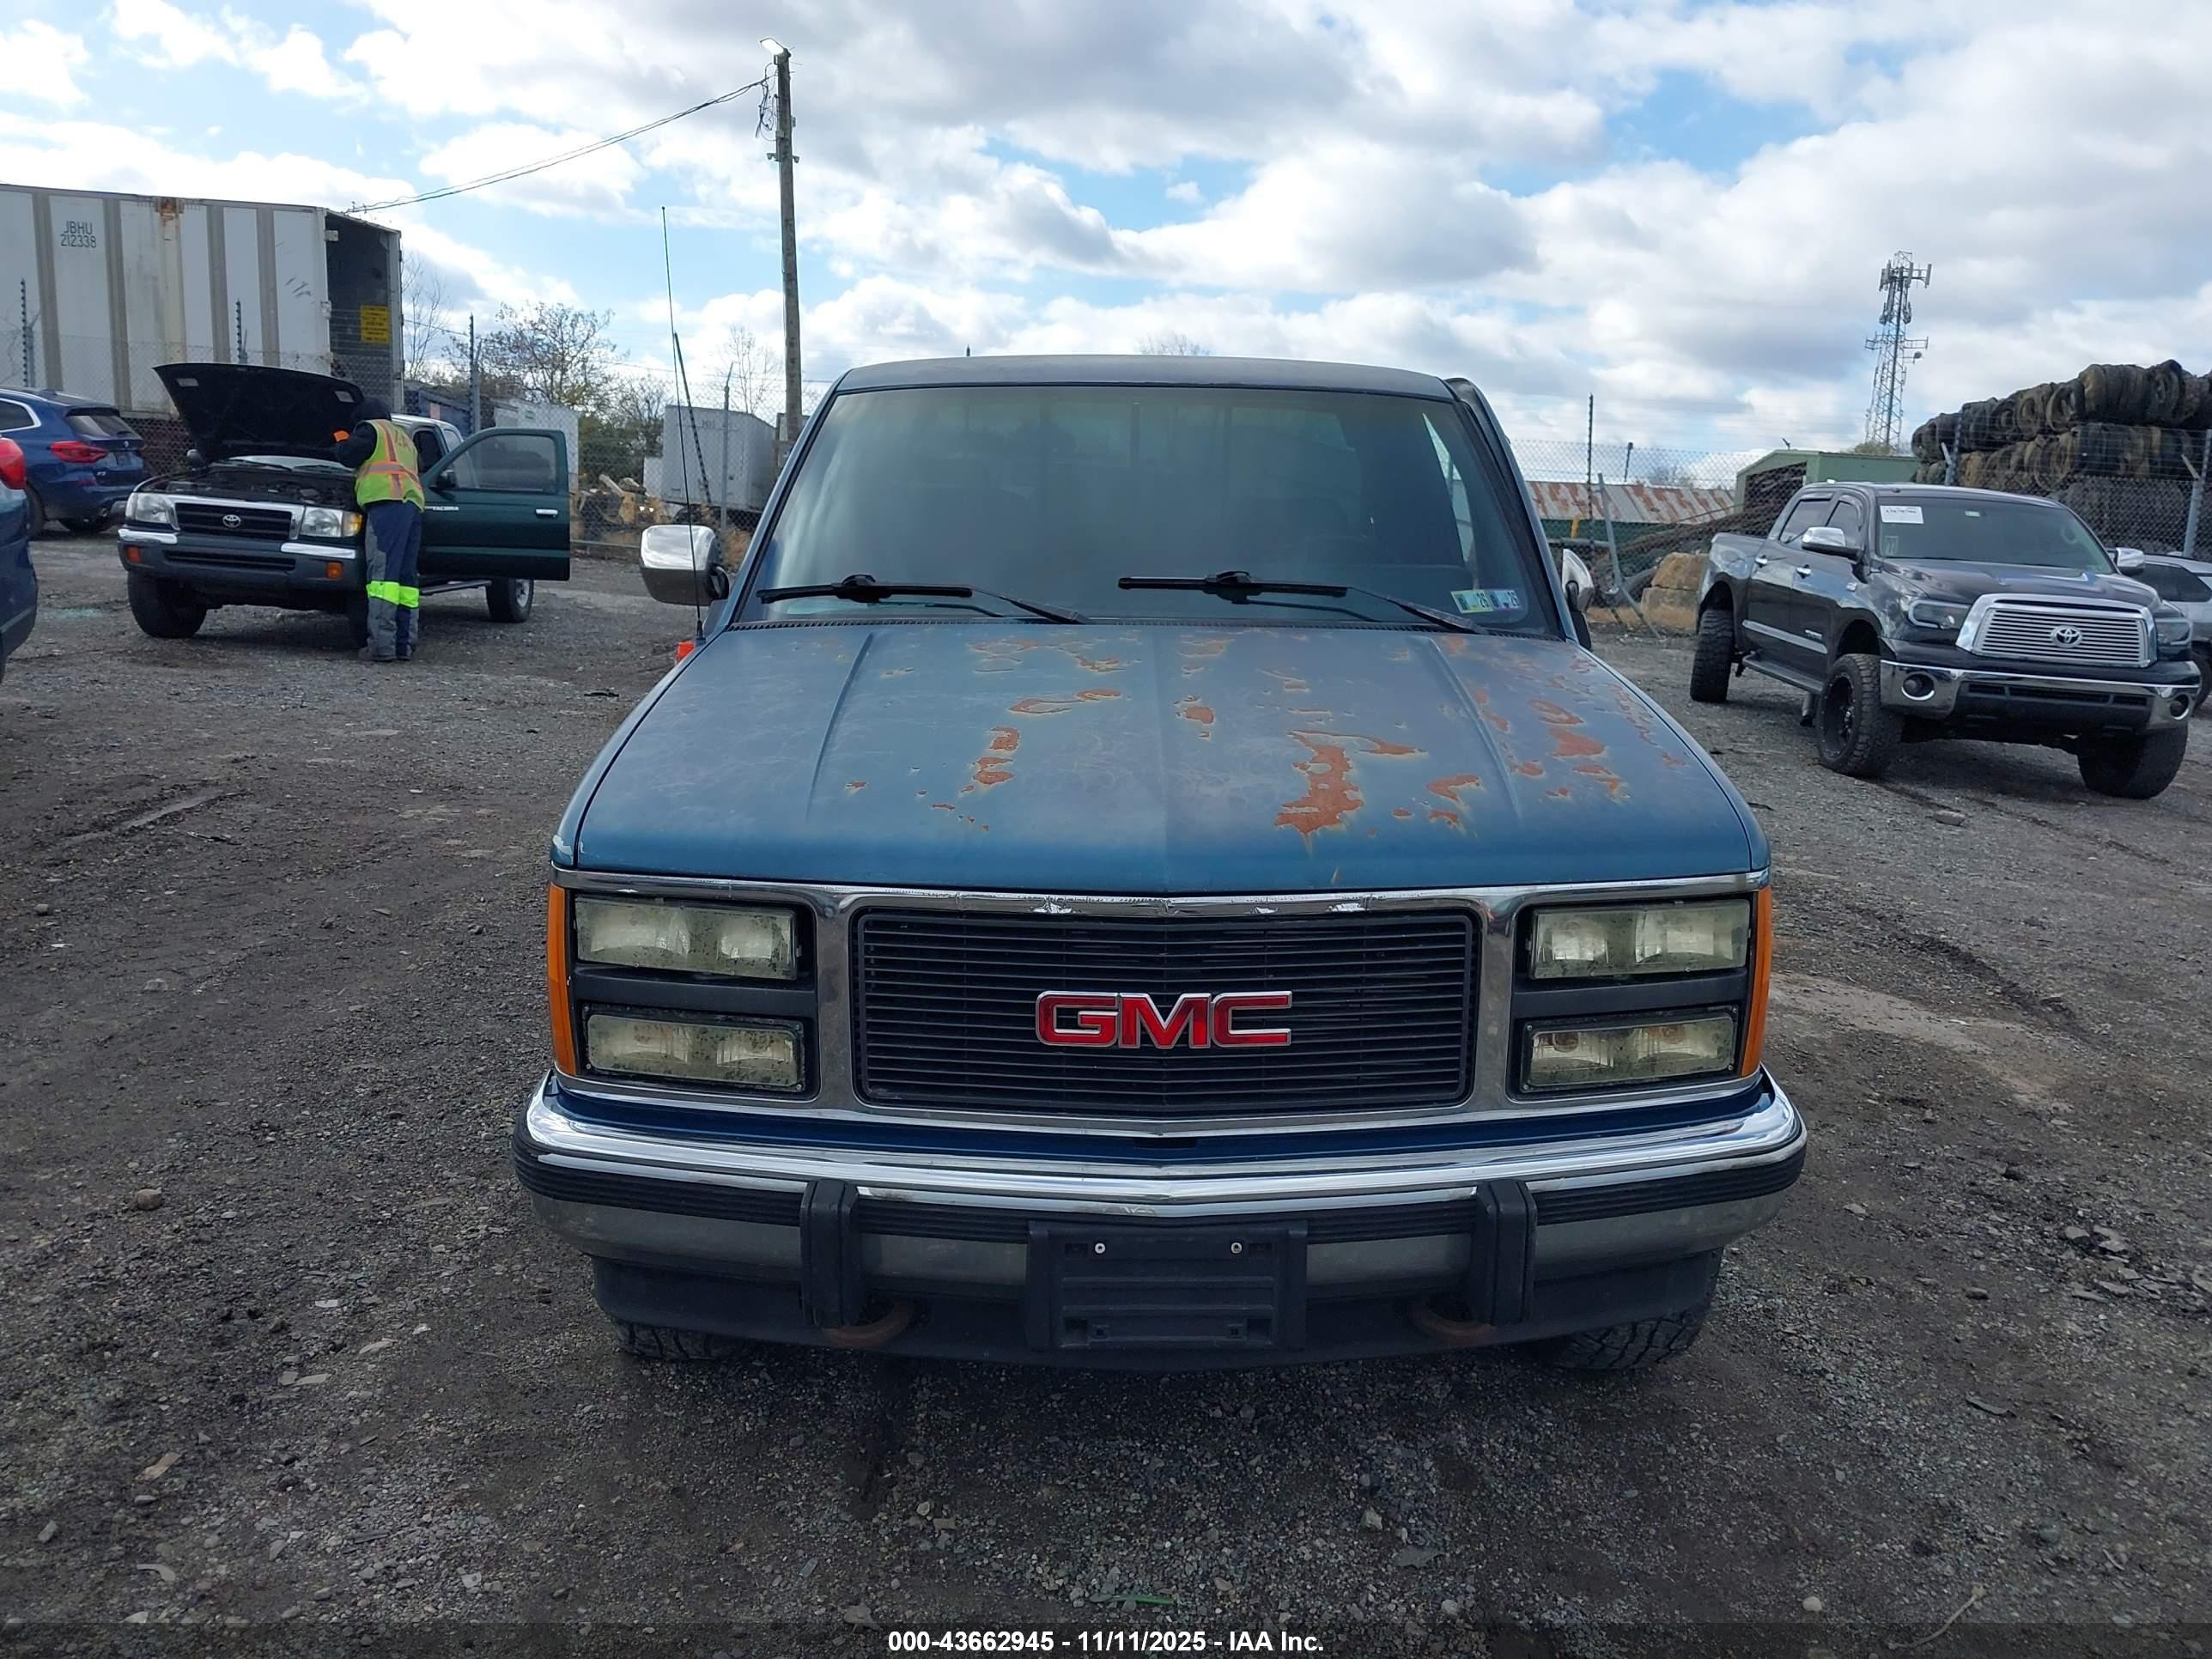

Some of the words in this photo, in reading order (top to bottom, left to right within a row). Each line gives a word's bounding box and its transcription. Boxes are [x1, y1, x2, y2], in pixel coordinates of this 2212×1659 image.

[63, 221, 94, 235] JBHU
[60, 234, 97, 248] 212338
[1036, 990, 1293, 1049] GMC
